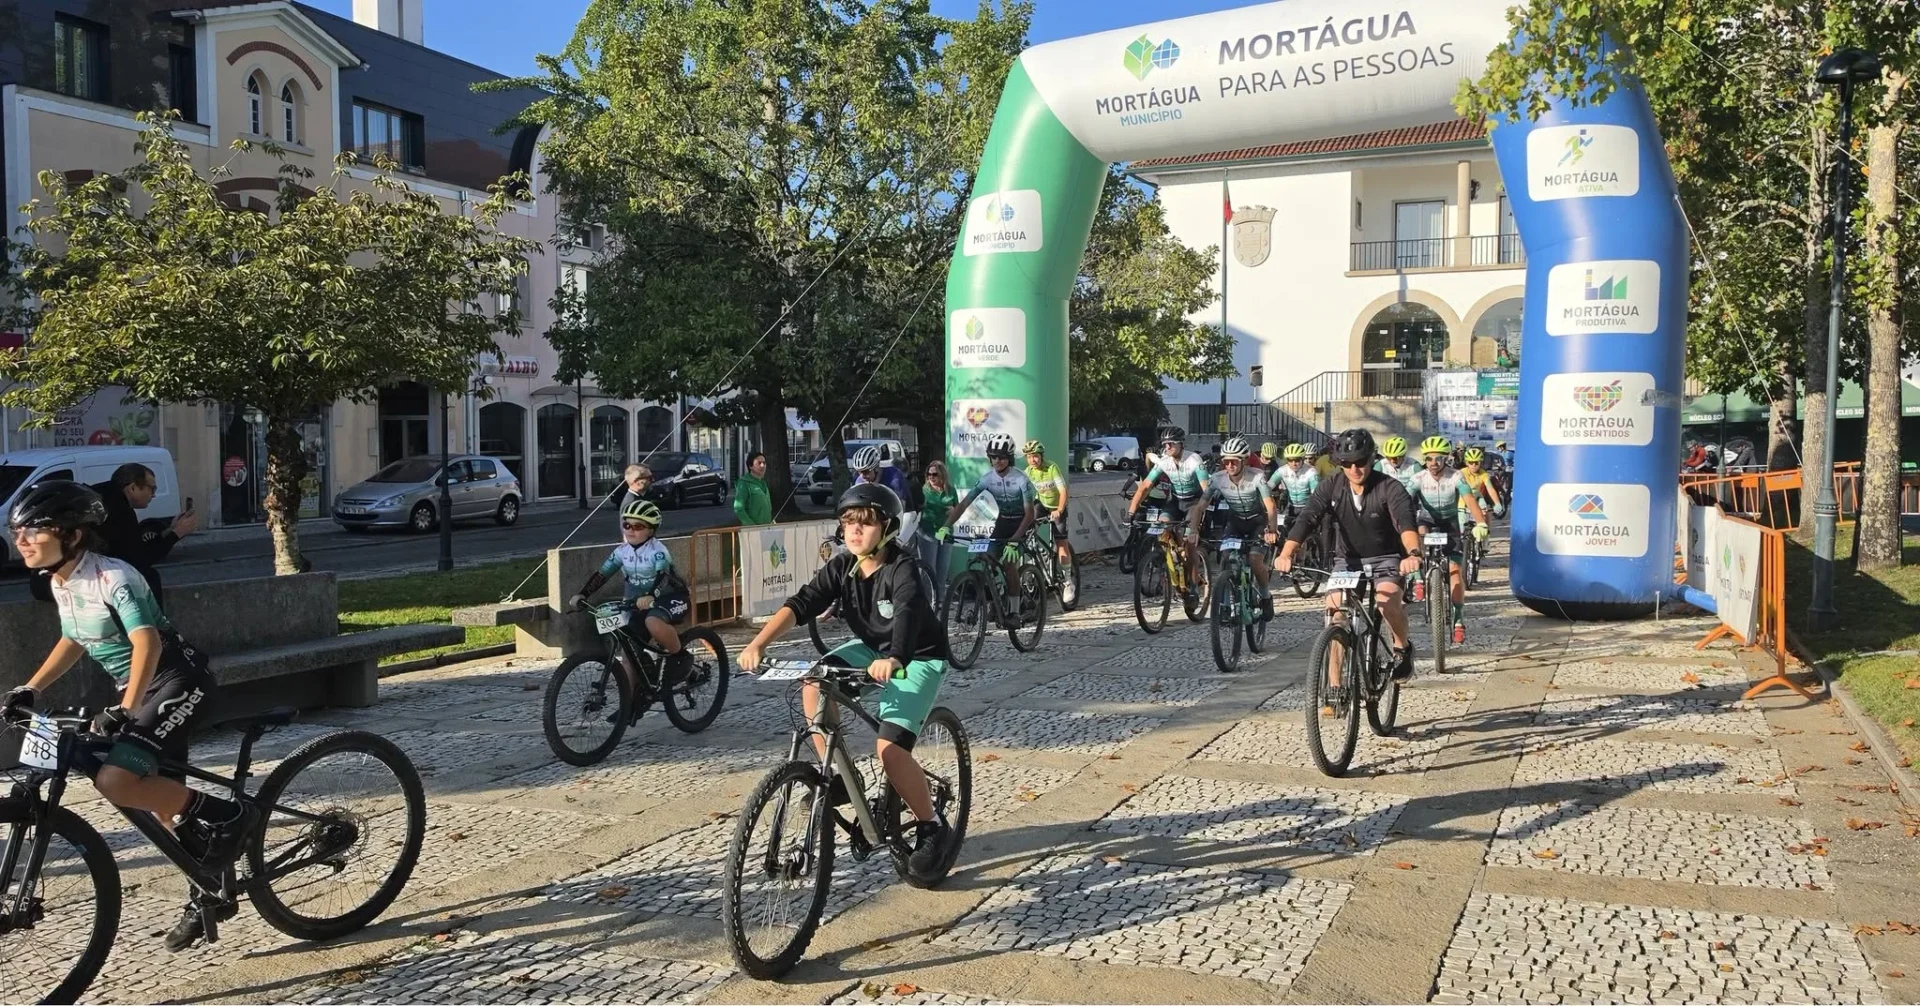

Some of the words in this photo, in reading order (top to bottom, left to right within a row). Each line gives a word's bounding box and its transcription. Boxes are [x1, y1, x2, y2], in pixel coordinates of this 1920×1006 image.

[1218, 10, 1417, 66] MORTÁGUA
[1218, 68, 1287, 98] PARA
[1293, 62, 1327, 88] AS
[1333, 42, 1455, 83] PESSOAS
[1095, 86, 1201, 115] MORTÁGUA
[1120, 108, 1183, 127] MUNICÍPIO
[1544, 170, 1619, 187] MORTÁGUA
[1578, 184, 1604, 193] ATIVA
[973, 230, 1027, 245] MORTÁGUA
[1563, 303, 1640, 319] MORTÁGUA
[1575, 318, 1627, 327] PRODUTIVA
[958, 342, 1010, 354] MORTÁGUA
[1558, 415, 1635, 428] MORTÁGUA
[55, 428, 67, 436] AO
[70, 428, 84, 436] SEU
[958, 430, 997, 442] MORTÁG
[1562, 430, 1581, 438] DOS
[1583, 430, 1630, 438] SENTIDOS
[55, 437, 85, 446] LADO
[958, 523, 995, 534] MORTÁG
[1554, 523, 1630, 537] MORTÁGUA
[1585, 538, 1617, 546] JOVEM
[1332, 578, 1354, 586] 301
[599, 616, 620, 629] 302
[154, 687, 204, 739] sagiper
[24, 737, 51, 760] 348
